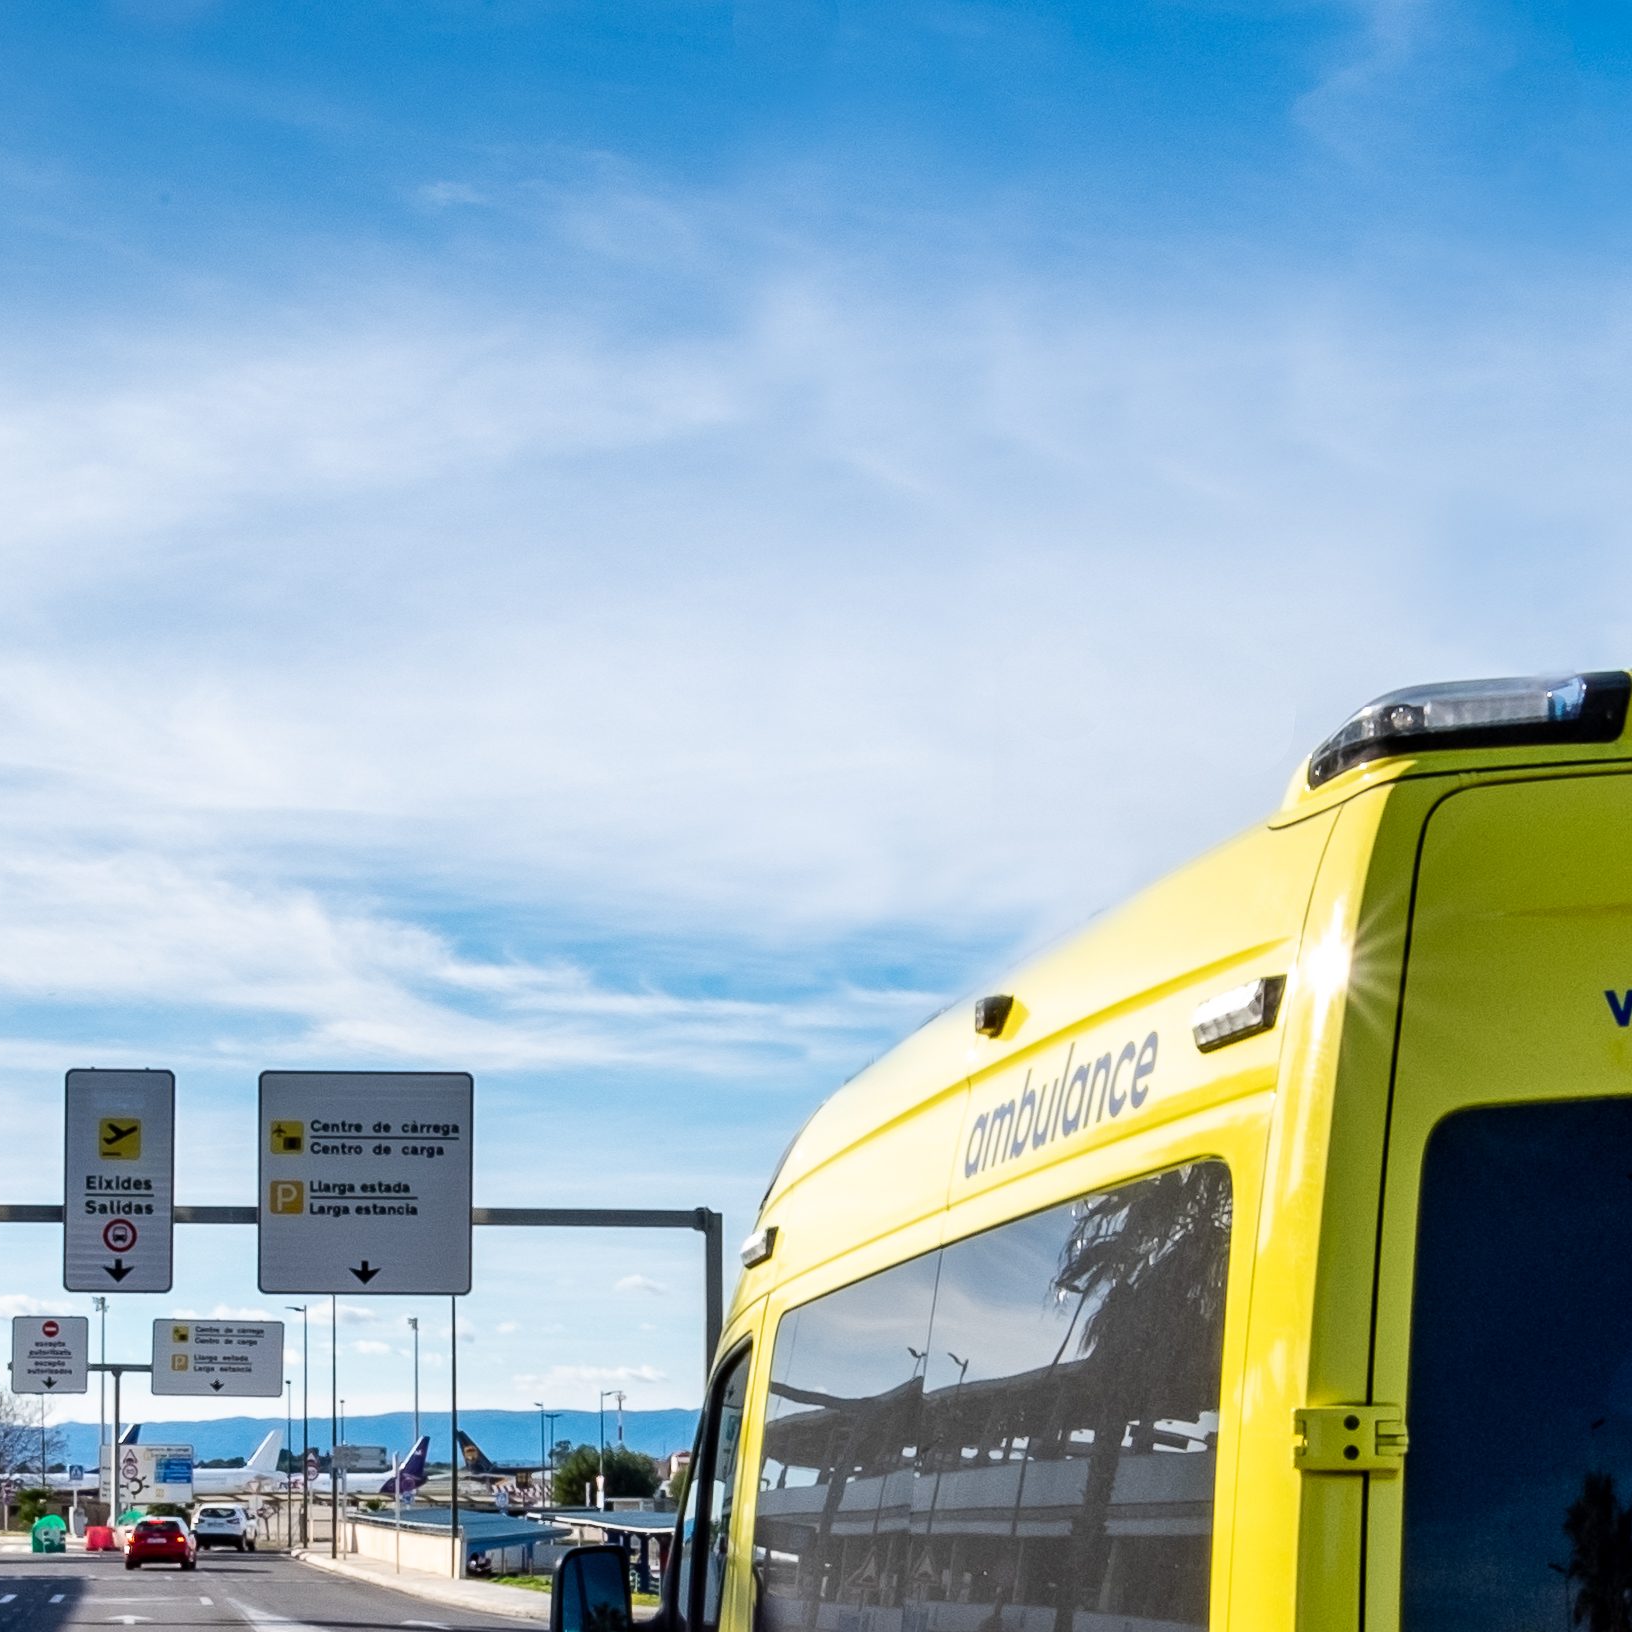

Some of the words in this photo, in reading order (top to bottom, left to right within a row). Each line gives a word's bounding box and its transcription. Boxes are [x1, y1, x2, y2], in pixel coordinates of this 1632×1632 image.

[963, 1029, 1161, 1180] ambulance
[310, 1119, 363, 1133] Centre
[372, 1120, 392, 1134] de
[401, 1120, 460, 1136] càrrega
[310, 1141, 363, 1155] Centro
[372, 1142, 392, 1156] de
[401, 1145, 445, 1159] carga
[85, 1175, 153, 1191] Eixides
[309, 1180, 356, 1196] Llarga
[360, 1181, 411, 1194] estada
[276, 1184, 298, 1211] P
[85, 1199, 154, 1215] Salidas
[309, 1202, 350, 1218] Larga
[354, 1203, 418, 1216] estancia
